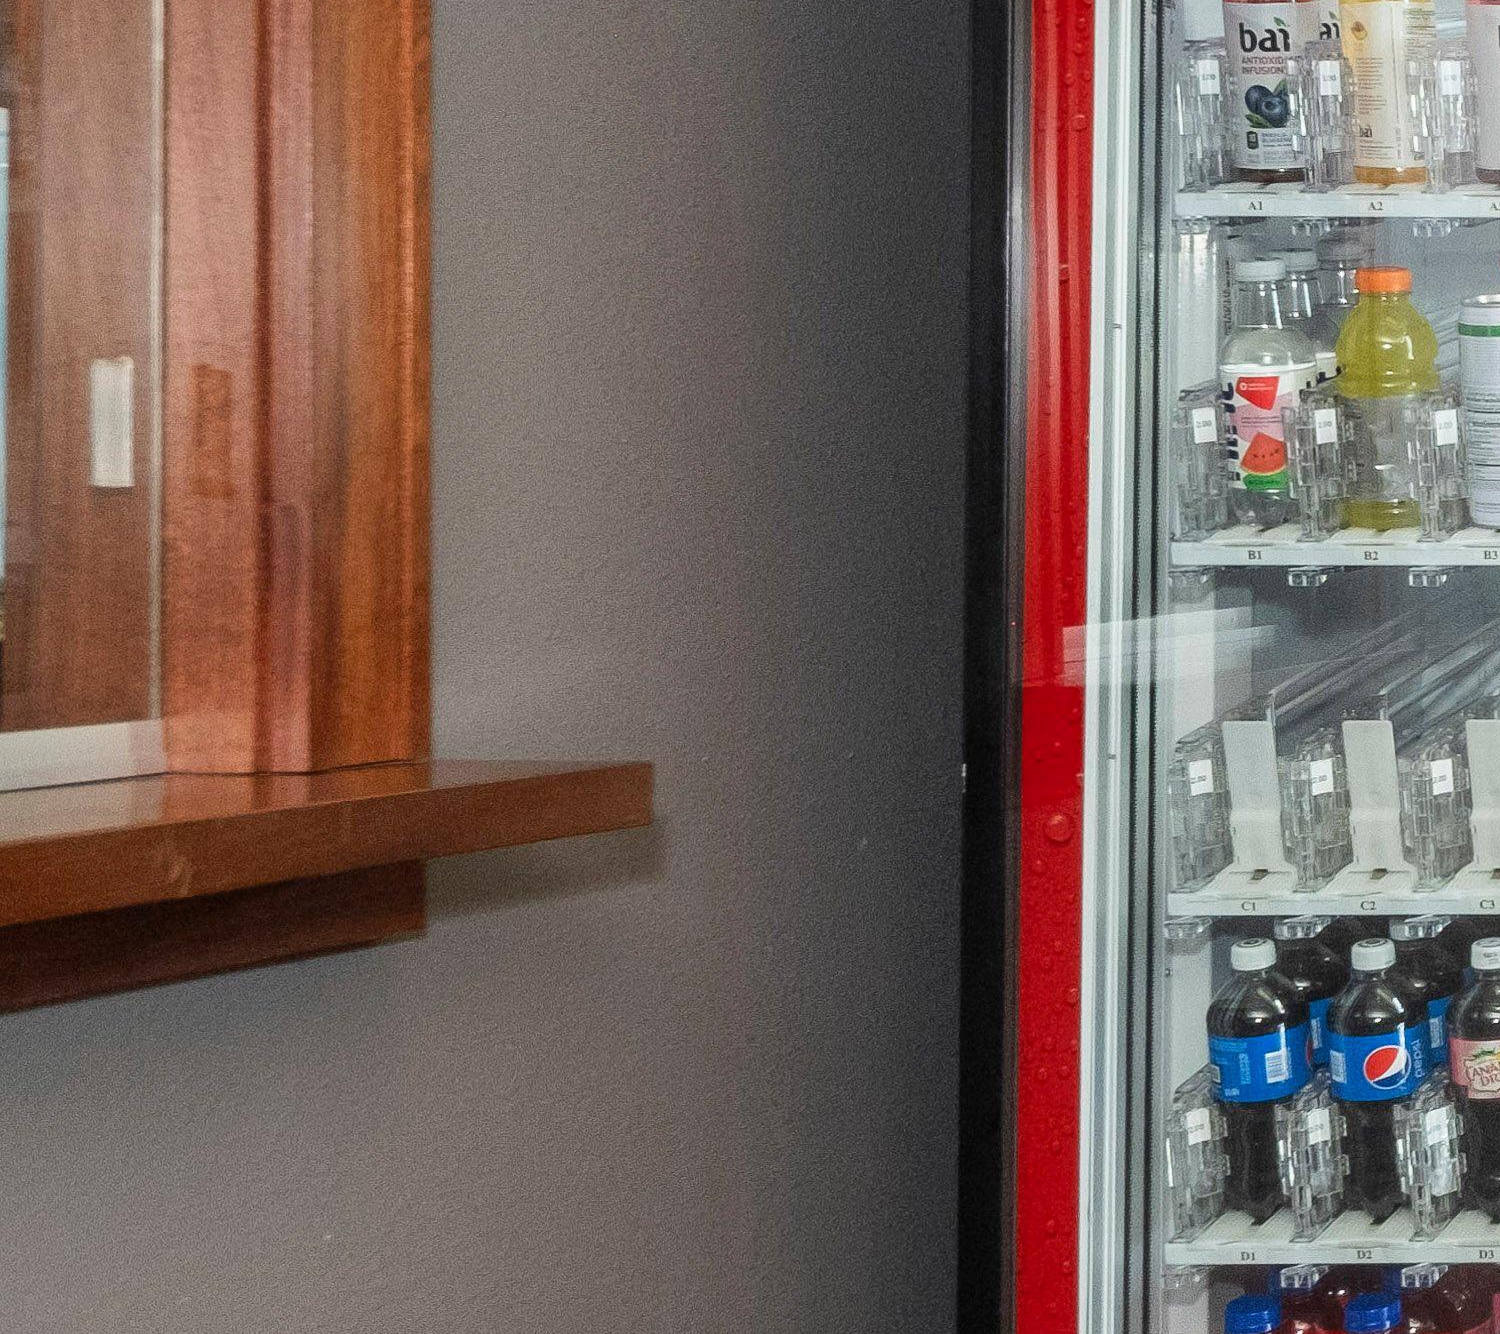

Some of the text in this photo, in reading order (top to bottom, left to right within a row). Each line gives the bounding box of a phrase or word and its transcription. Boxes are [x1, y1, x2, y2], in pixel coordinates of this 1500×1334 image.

[1248, 201, 1264, 212] A1
[1368, 201, 1383, 212] A2
[1248, 550, 1262, 560] B1
[1364, 550, 1378, 560] B2
[1484, 550, 1498, 560] B3
[1241, 900, 1256, 911] C1
[1360, 900, 1376, 910] C2
[1479, 899, 1495, 910] C3
[1240, 1251, 1256, 1260] D1
[1357, 1250, 1372, 1259] D2
[1479, 1249, 1494, 1260] D3
